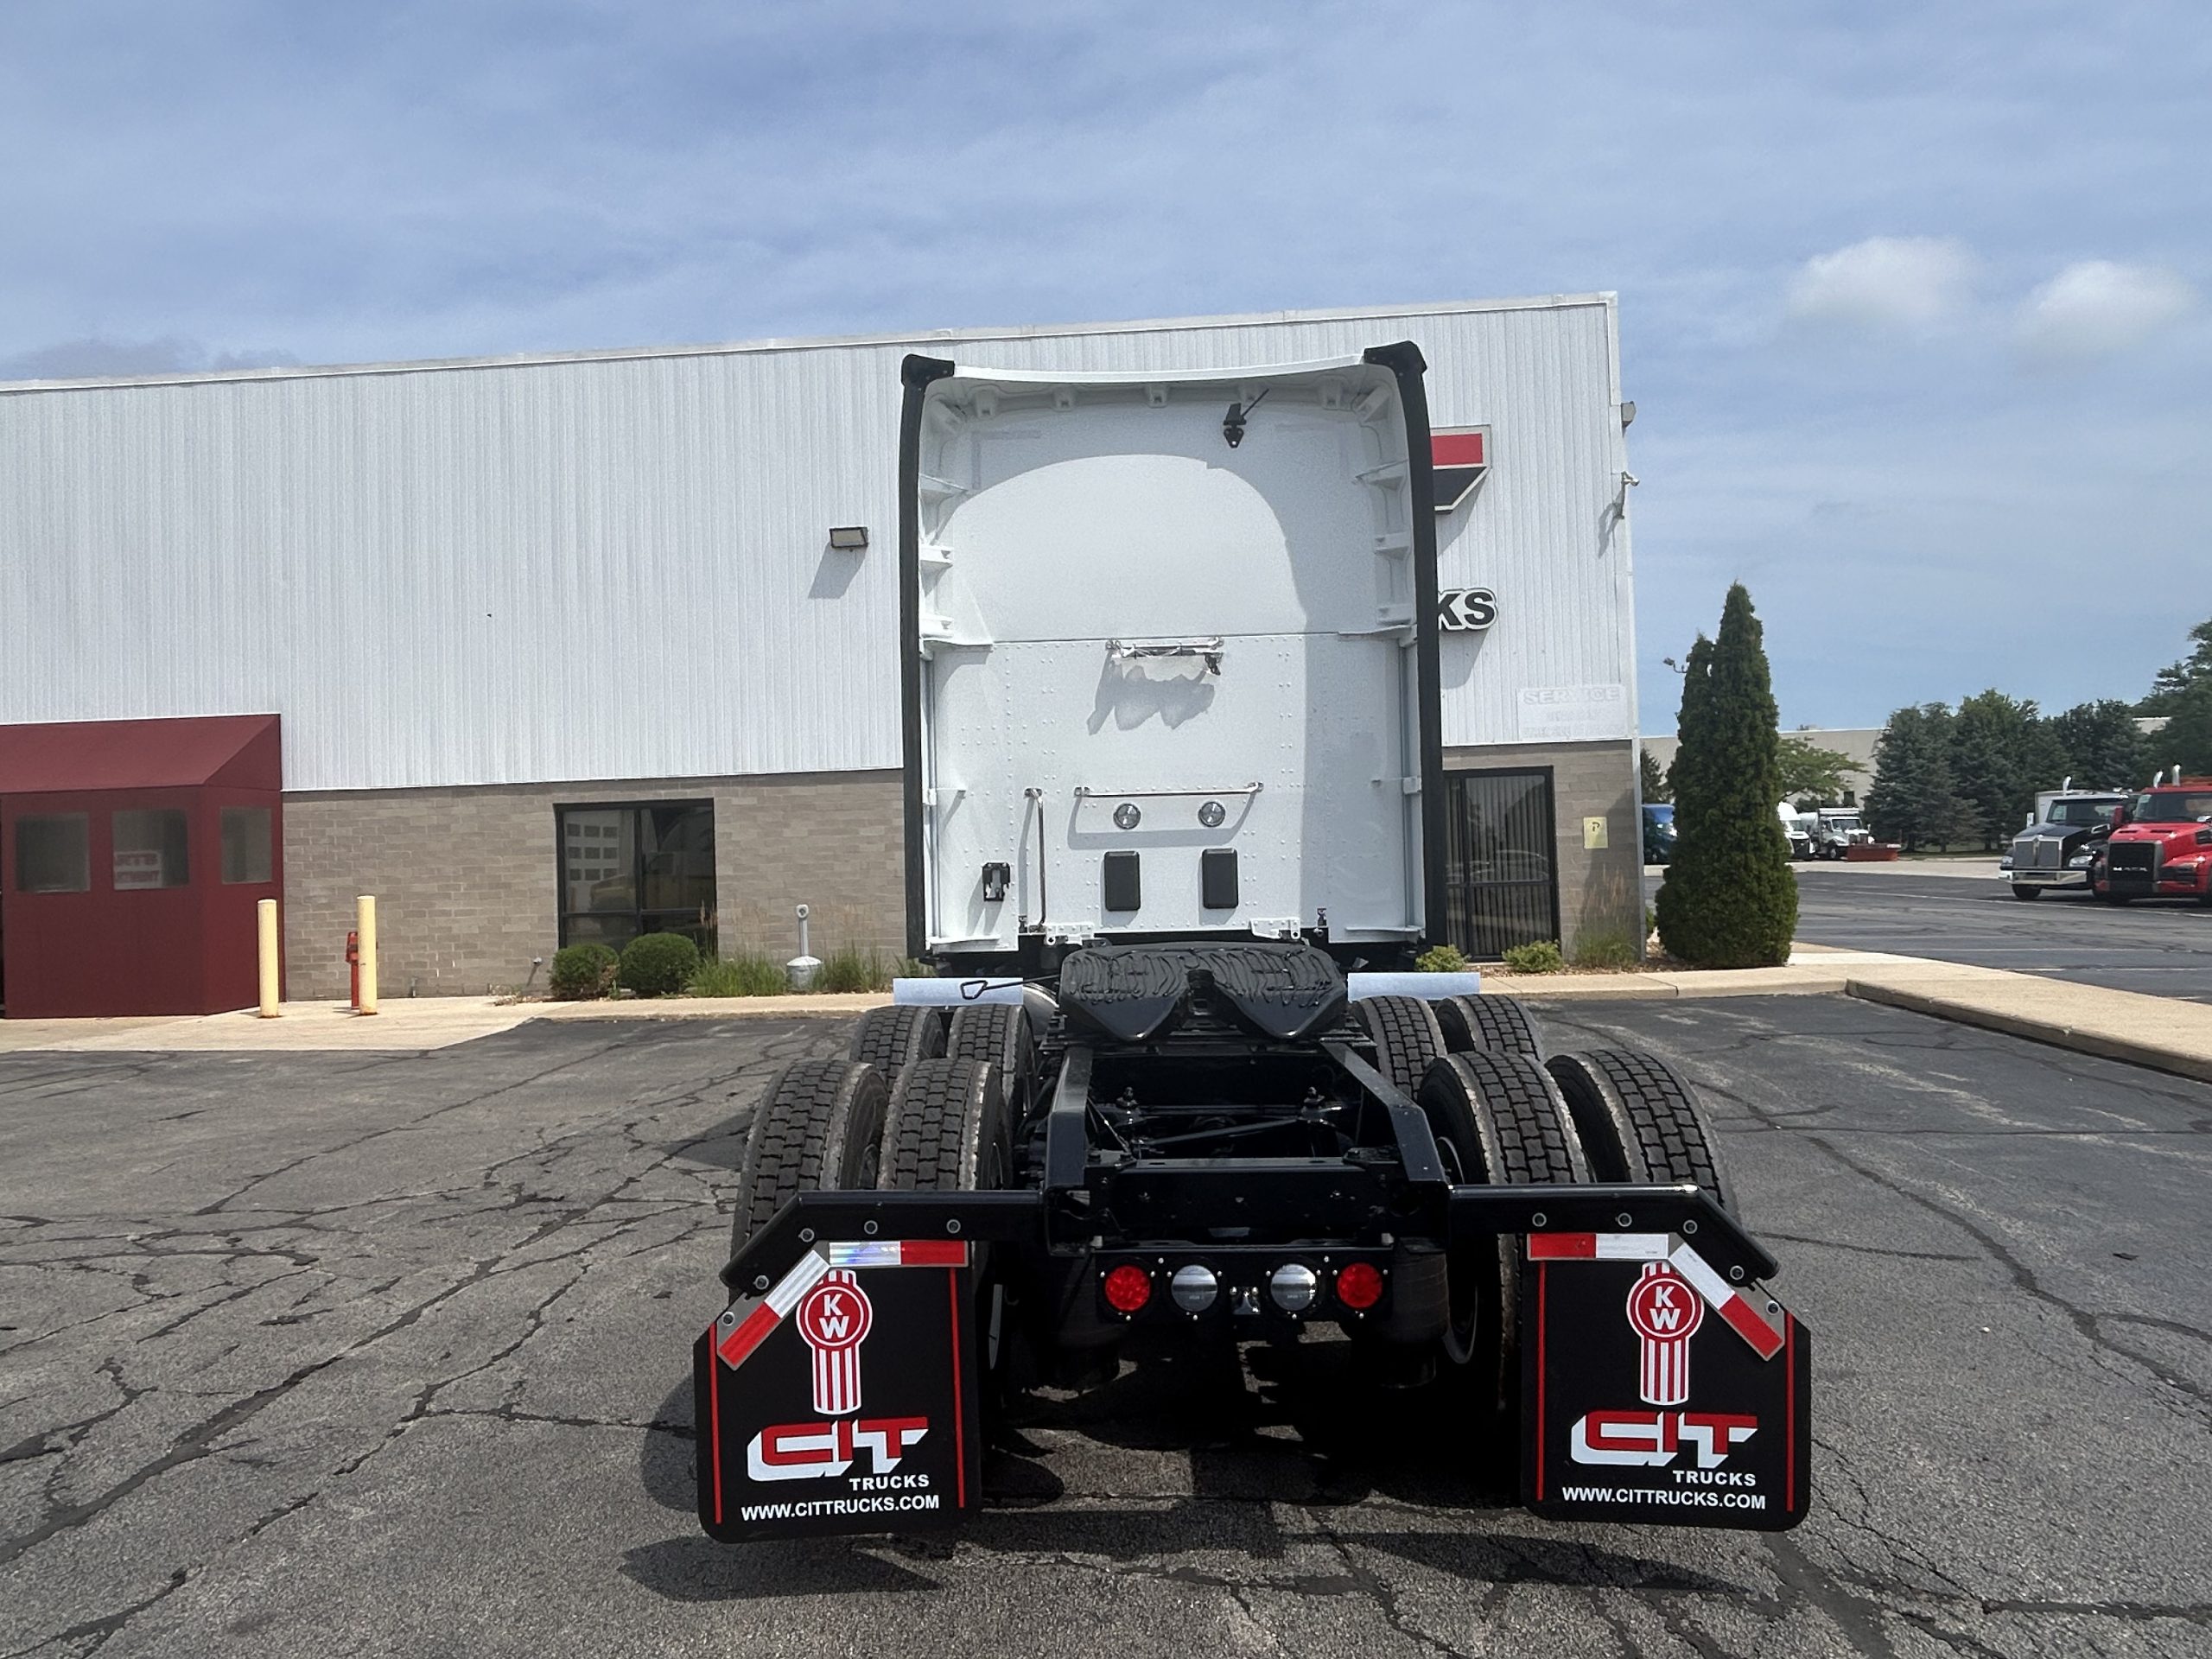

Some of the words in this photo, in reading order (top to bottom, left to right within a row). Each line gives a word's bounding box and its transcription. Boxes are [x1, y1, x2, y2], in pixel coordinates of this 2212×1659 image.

[1523, 687, 1620, 705] SERICE
[747, 1416, 929, 1482] CIT
[1571, 1410, 1758, 1469] CIT
[849, 1474, 930, 1491] TRUCKS
[1672, 1470, 1757, 1487] TRUCKS
[741, 1495, 940, 1522] WWW.CITTRUCKS.COM
[1562, 1487, 1766, 1510] WWW.CITTRUCKS.COM
